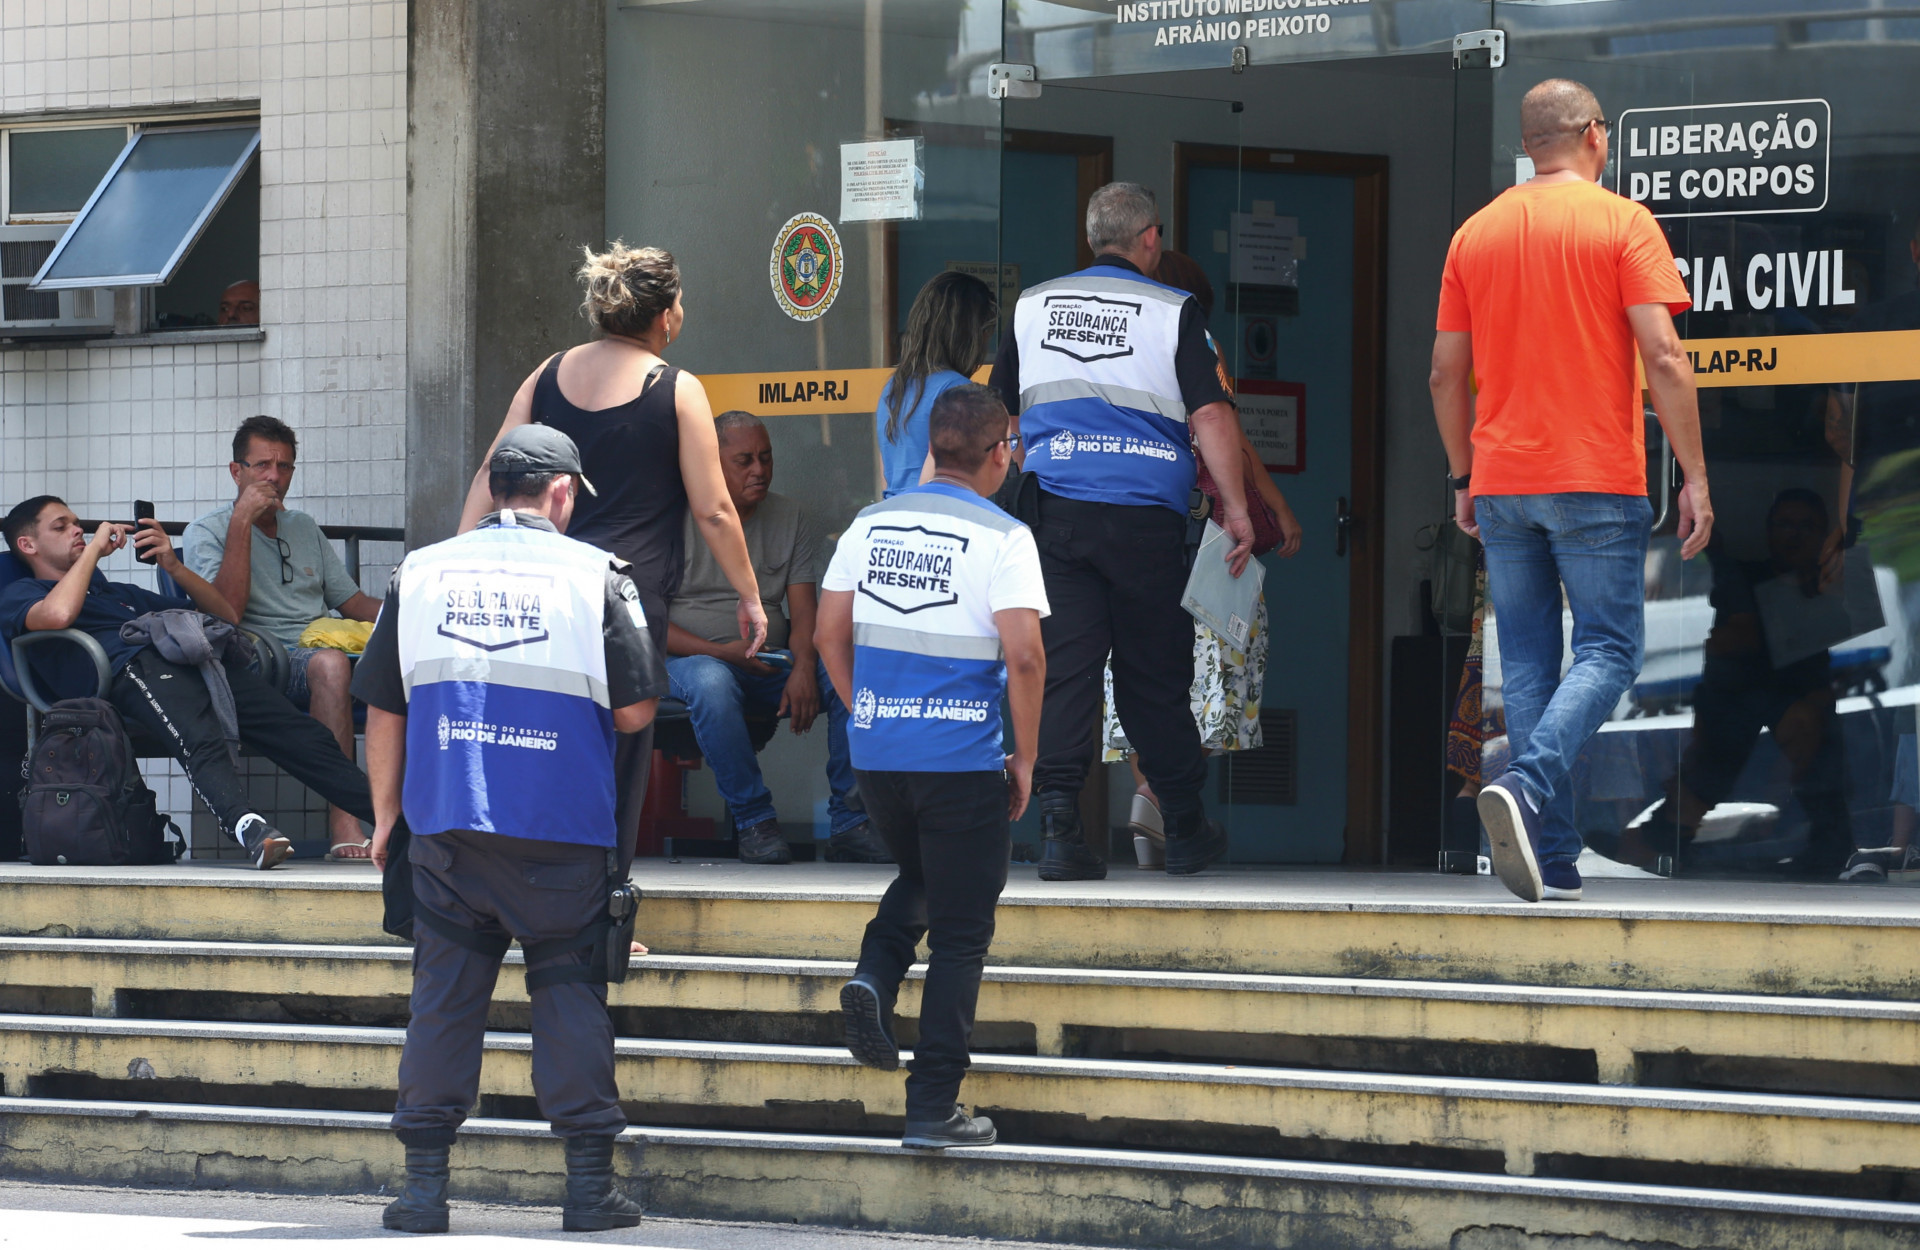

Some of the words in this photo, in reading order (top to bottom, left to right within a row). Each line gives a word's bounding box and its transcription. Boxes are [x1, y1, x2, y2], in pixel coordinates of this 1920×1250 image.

[1117, 0, 1220, 23] INSTITUTO
[1154, 19, 1241, 46] AFRÂNIO
[1245, 13, 1330, 39] PEIXOTO
[1629, 112, 1818, 159] LIBERAÇÃO
[1629, 170, 1671, 201] DE
[1679, 164, 1815, 199] CORPOS
[1746, 249, 1856, 310] CIVIL
[1048, 311, 1127, 334] SEGURANÇA
[1047, 329, 1126, 347] PRESENTE
[1686, 347, 1777, 374] LAP-RJ
[759, 380, 849, 404] IMLAP-RJ
[1077, 441, 1101, 452] RIO
[1103, 442, 1120, 453] DE
[1123, 443, 1177, 462] JANEIRO
[1078, 434, 1121, 442] GOVERNO
[1143, 440, 1175, 450] ESTADO
[873, 538, 904, 546] OPERAÇÃO
[868, 547, 952, 577] SEGURANÇA
[867, 570, 950, 594] PRESENTE
[446, 588, 541, 613] SEGURANÇA
[445, 612, 540, 630] PRESENTE
[877, 704, 899, 718] RIO
[900, 705, 921, 718] DE
[923, 706, 987, 722] JANEIRO
[879, 696, 922, 704] GOVERNO
[928, 697, 943, 705] DO
[948, 698, 989, 708] ESTADO
[451, 720, 497, 730] GOVERNO
[502, 726, 515, 734] DO
[520, 728, 558, 738] ESTADO
[451, 728, 476, 741] RIO
[477, 731, 496, 744] DE
[498, 734, 557, 751] JANEIRO
